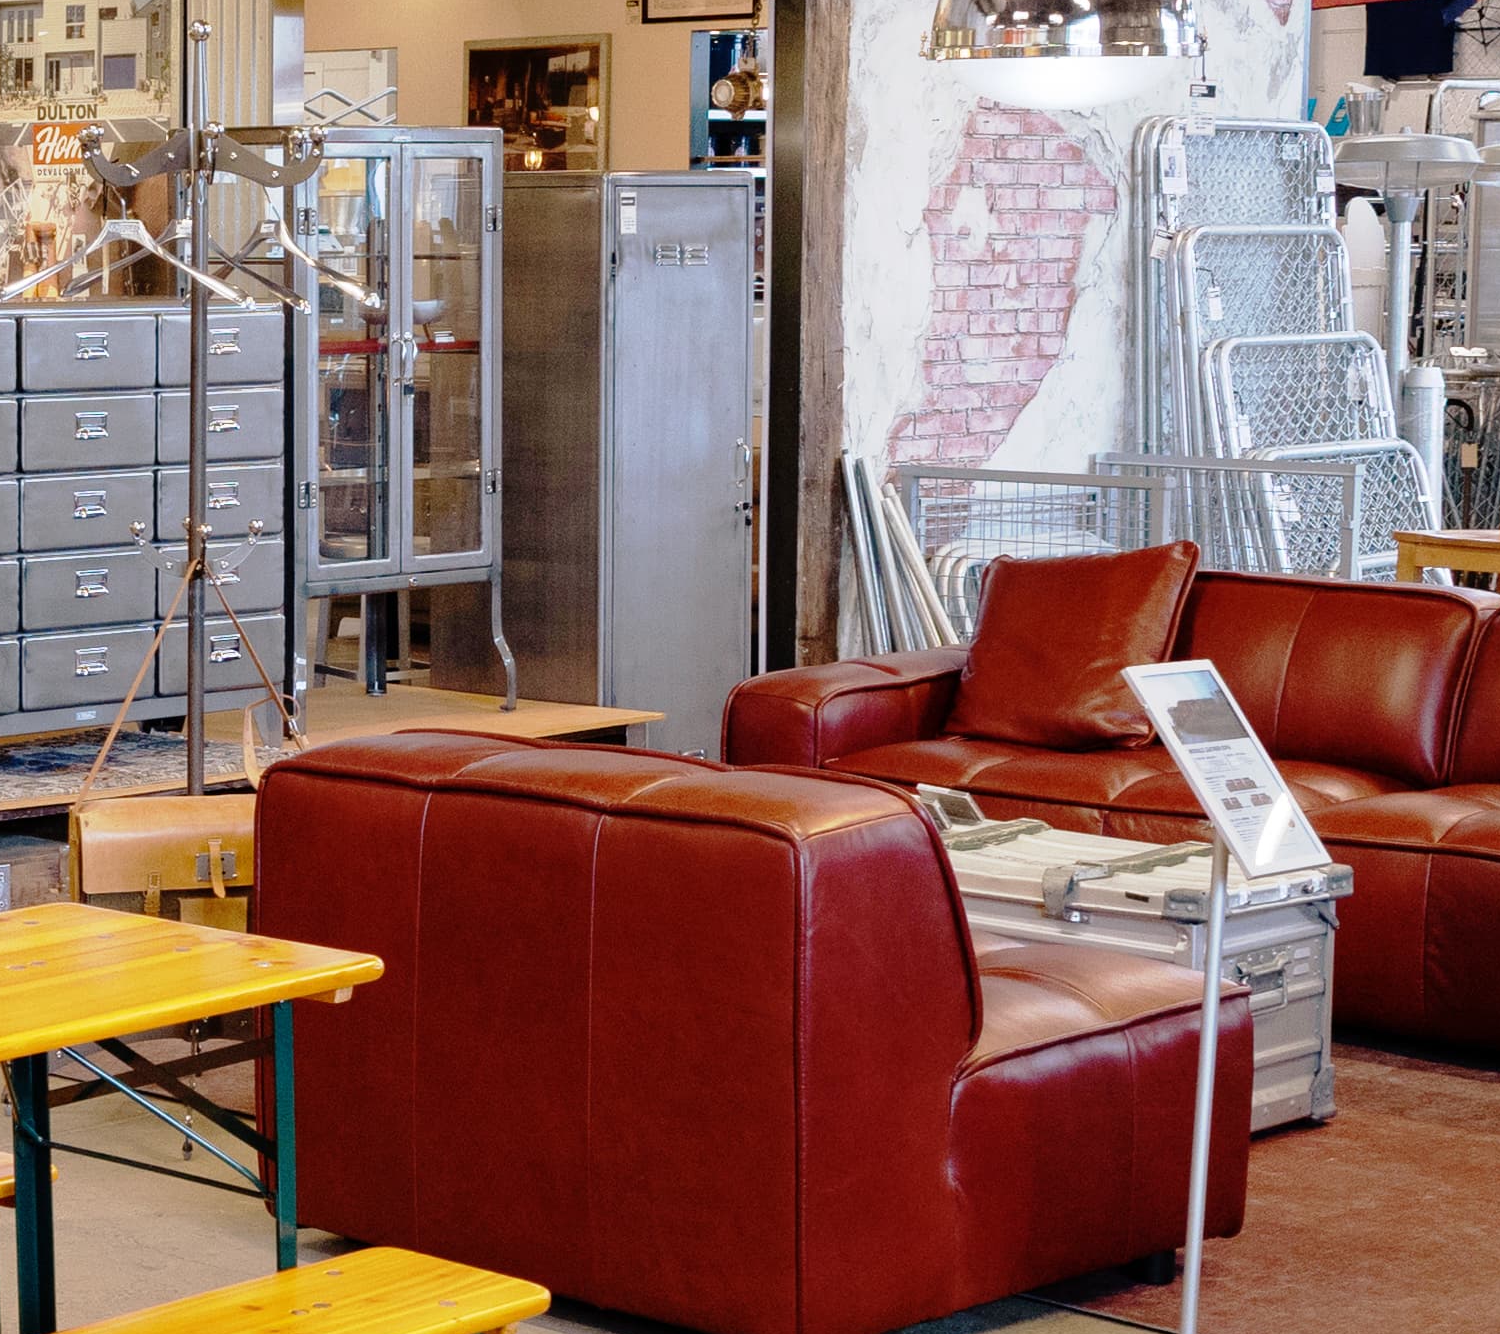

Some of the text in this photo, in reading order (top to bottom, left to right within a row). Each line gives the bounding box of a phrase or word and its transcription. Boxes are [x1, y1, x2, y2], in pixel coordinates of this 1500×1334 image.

[37, 104, 98, 121] DULTON
[36, 126, 83, 164] Hom
[37, 168, 88, 176] DEVELOPME
